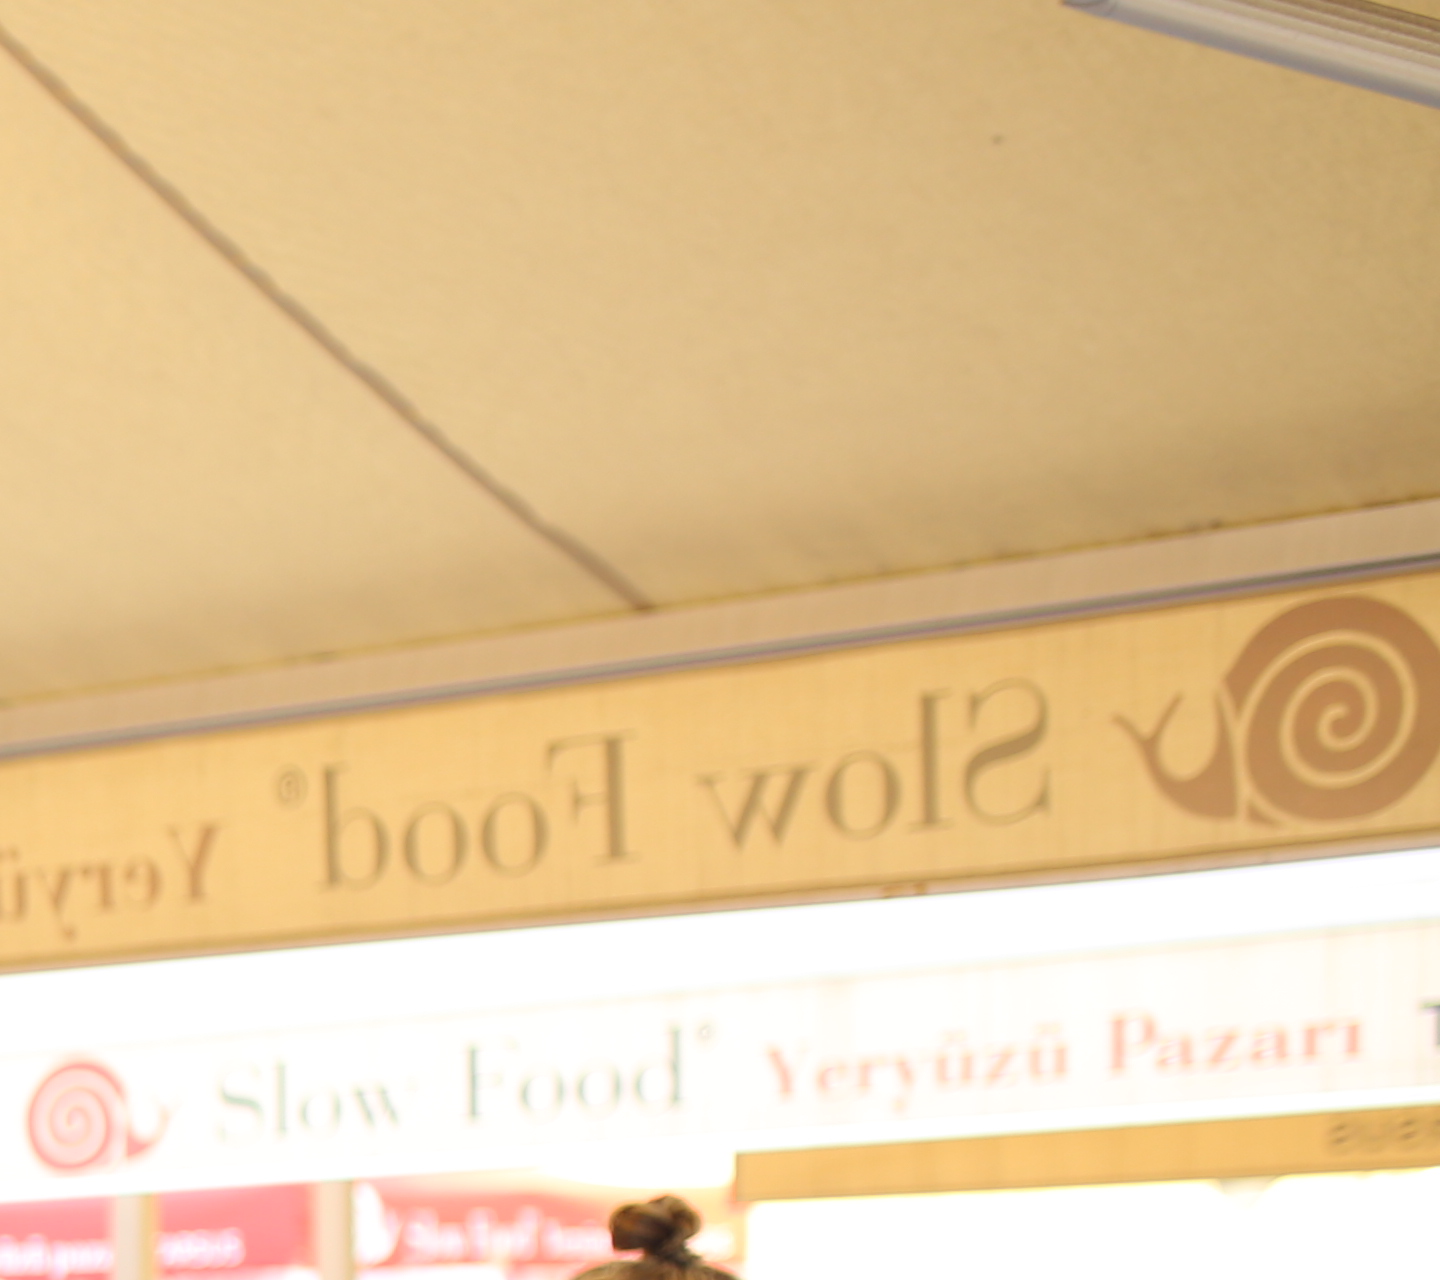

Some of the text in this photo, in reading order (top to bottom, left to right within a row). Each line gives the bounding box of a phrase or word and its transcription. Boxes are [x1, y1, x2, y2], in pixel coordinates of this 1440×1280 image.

[216, 1058, 418, 1145] Slow
[764, 1024, 1071, 1115] Yeryüzü
[1107, 1009, 1363, 1077] Pazarı
